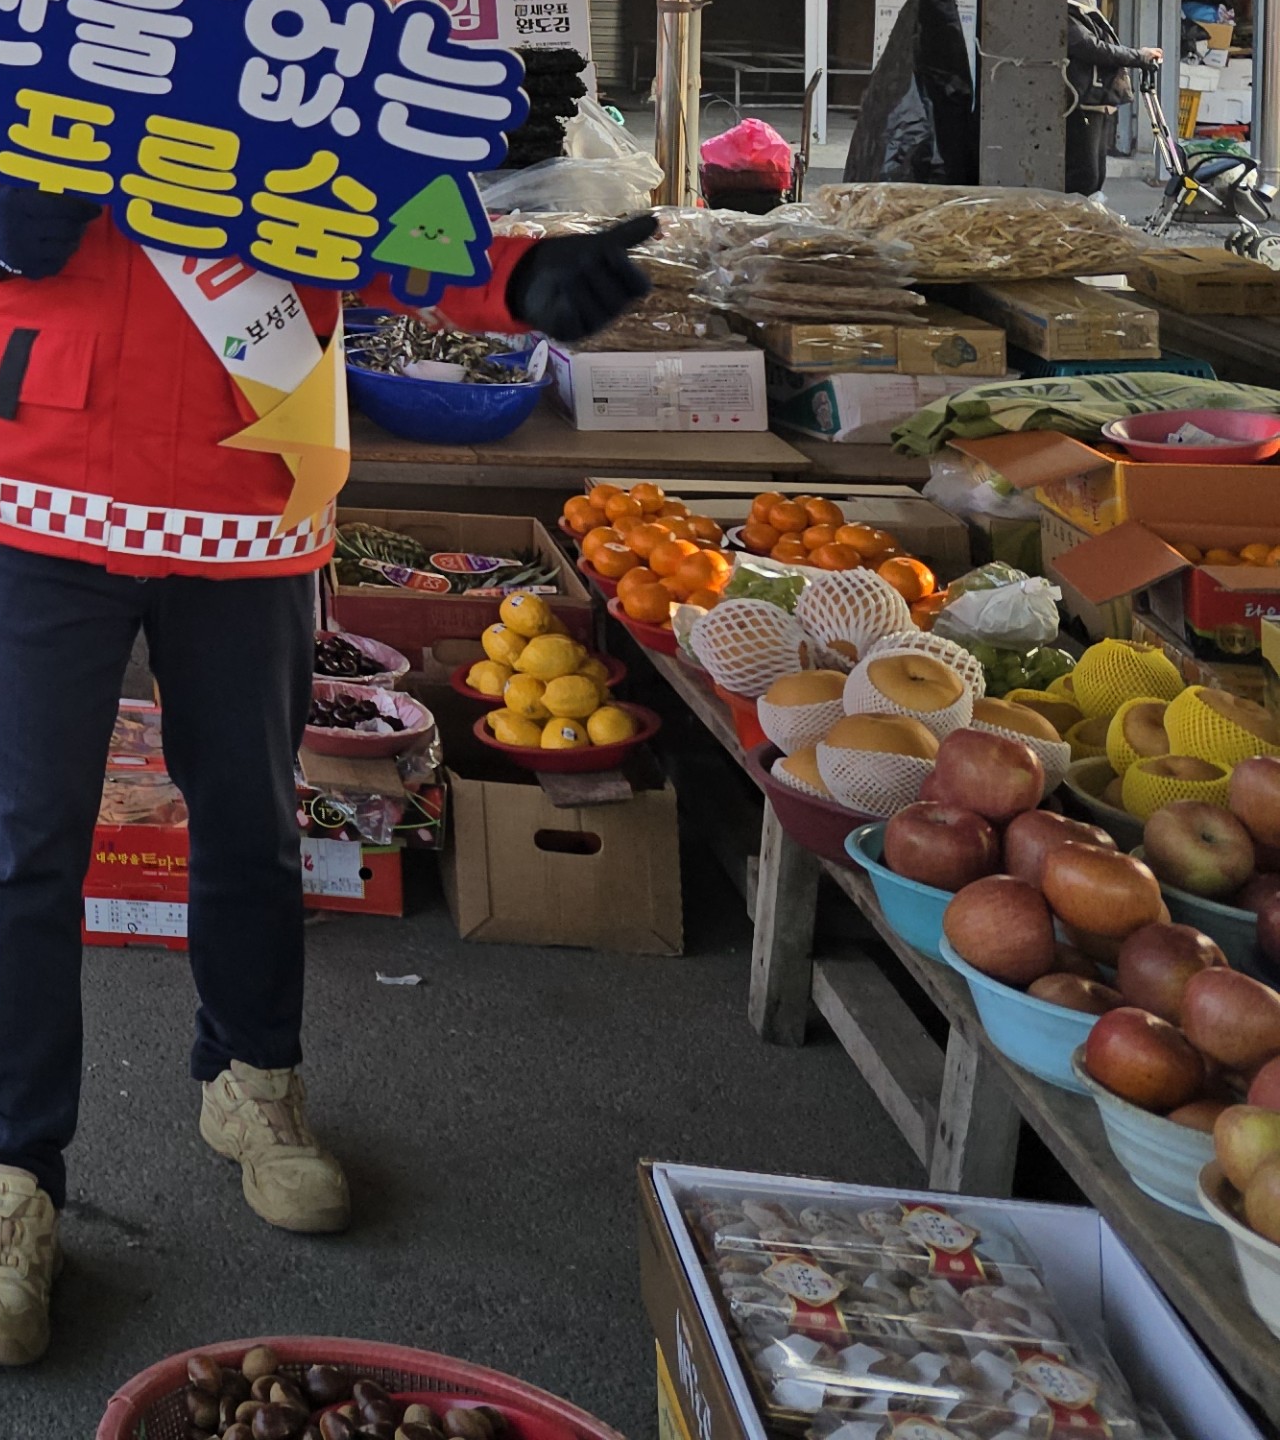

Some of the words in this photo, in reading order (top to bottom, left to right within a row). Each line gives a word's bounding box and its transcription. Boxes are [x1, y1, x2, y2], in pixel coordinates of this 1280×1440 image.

[529, 3, 570, 17] 새우표
[515, 17, 572, 35] 완도김
[244, 292, 301, 346] 보성군
